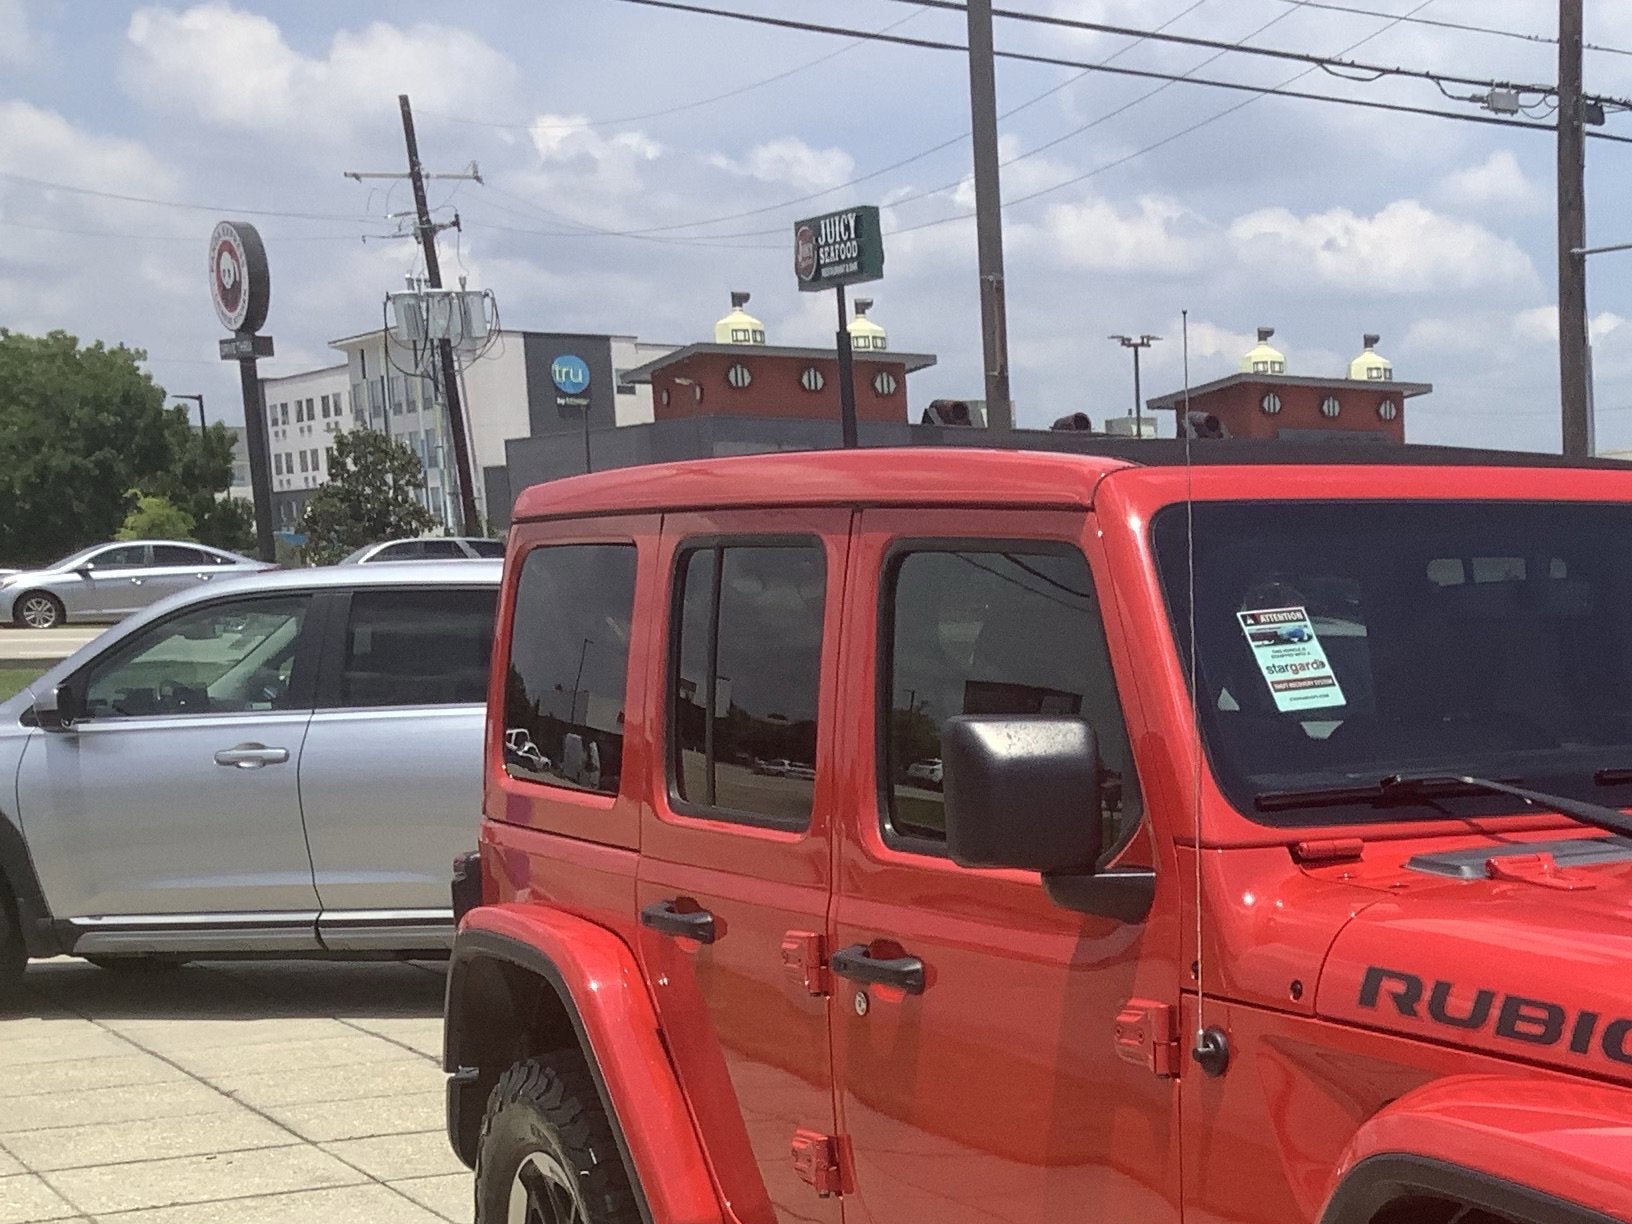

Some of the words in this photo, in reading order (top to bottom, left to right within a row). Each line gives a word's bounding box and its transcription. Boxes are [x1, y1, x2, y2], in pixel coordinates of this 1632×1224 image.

[818, 212, 857, 245] JUICY
[819, 241, 858, 264] SEAFOOD
[552, 363, 583, 383] tru
[1260, 611, 1304, 624] ATTENTION
